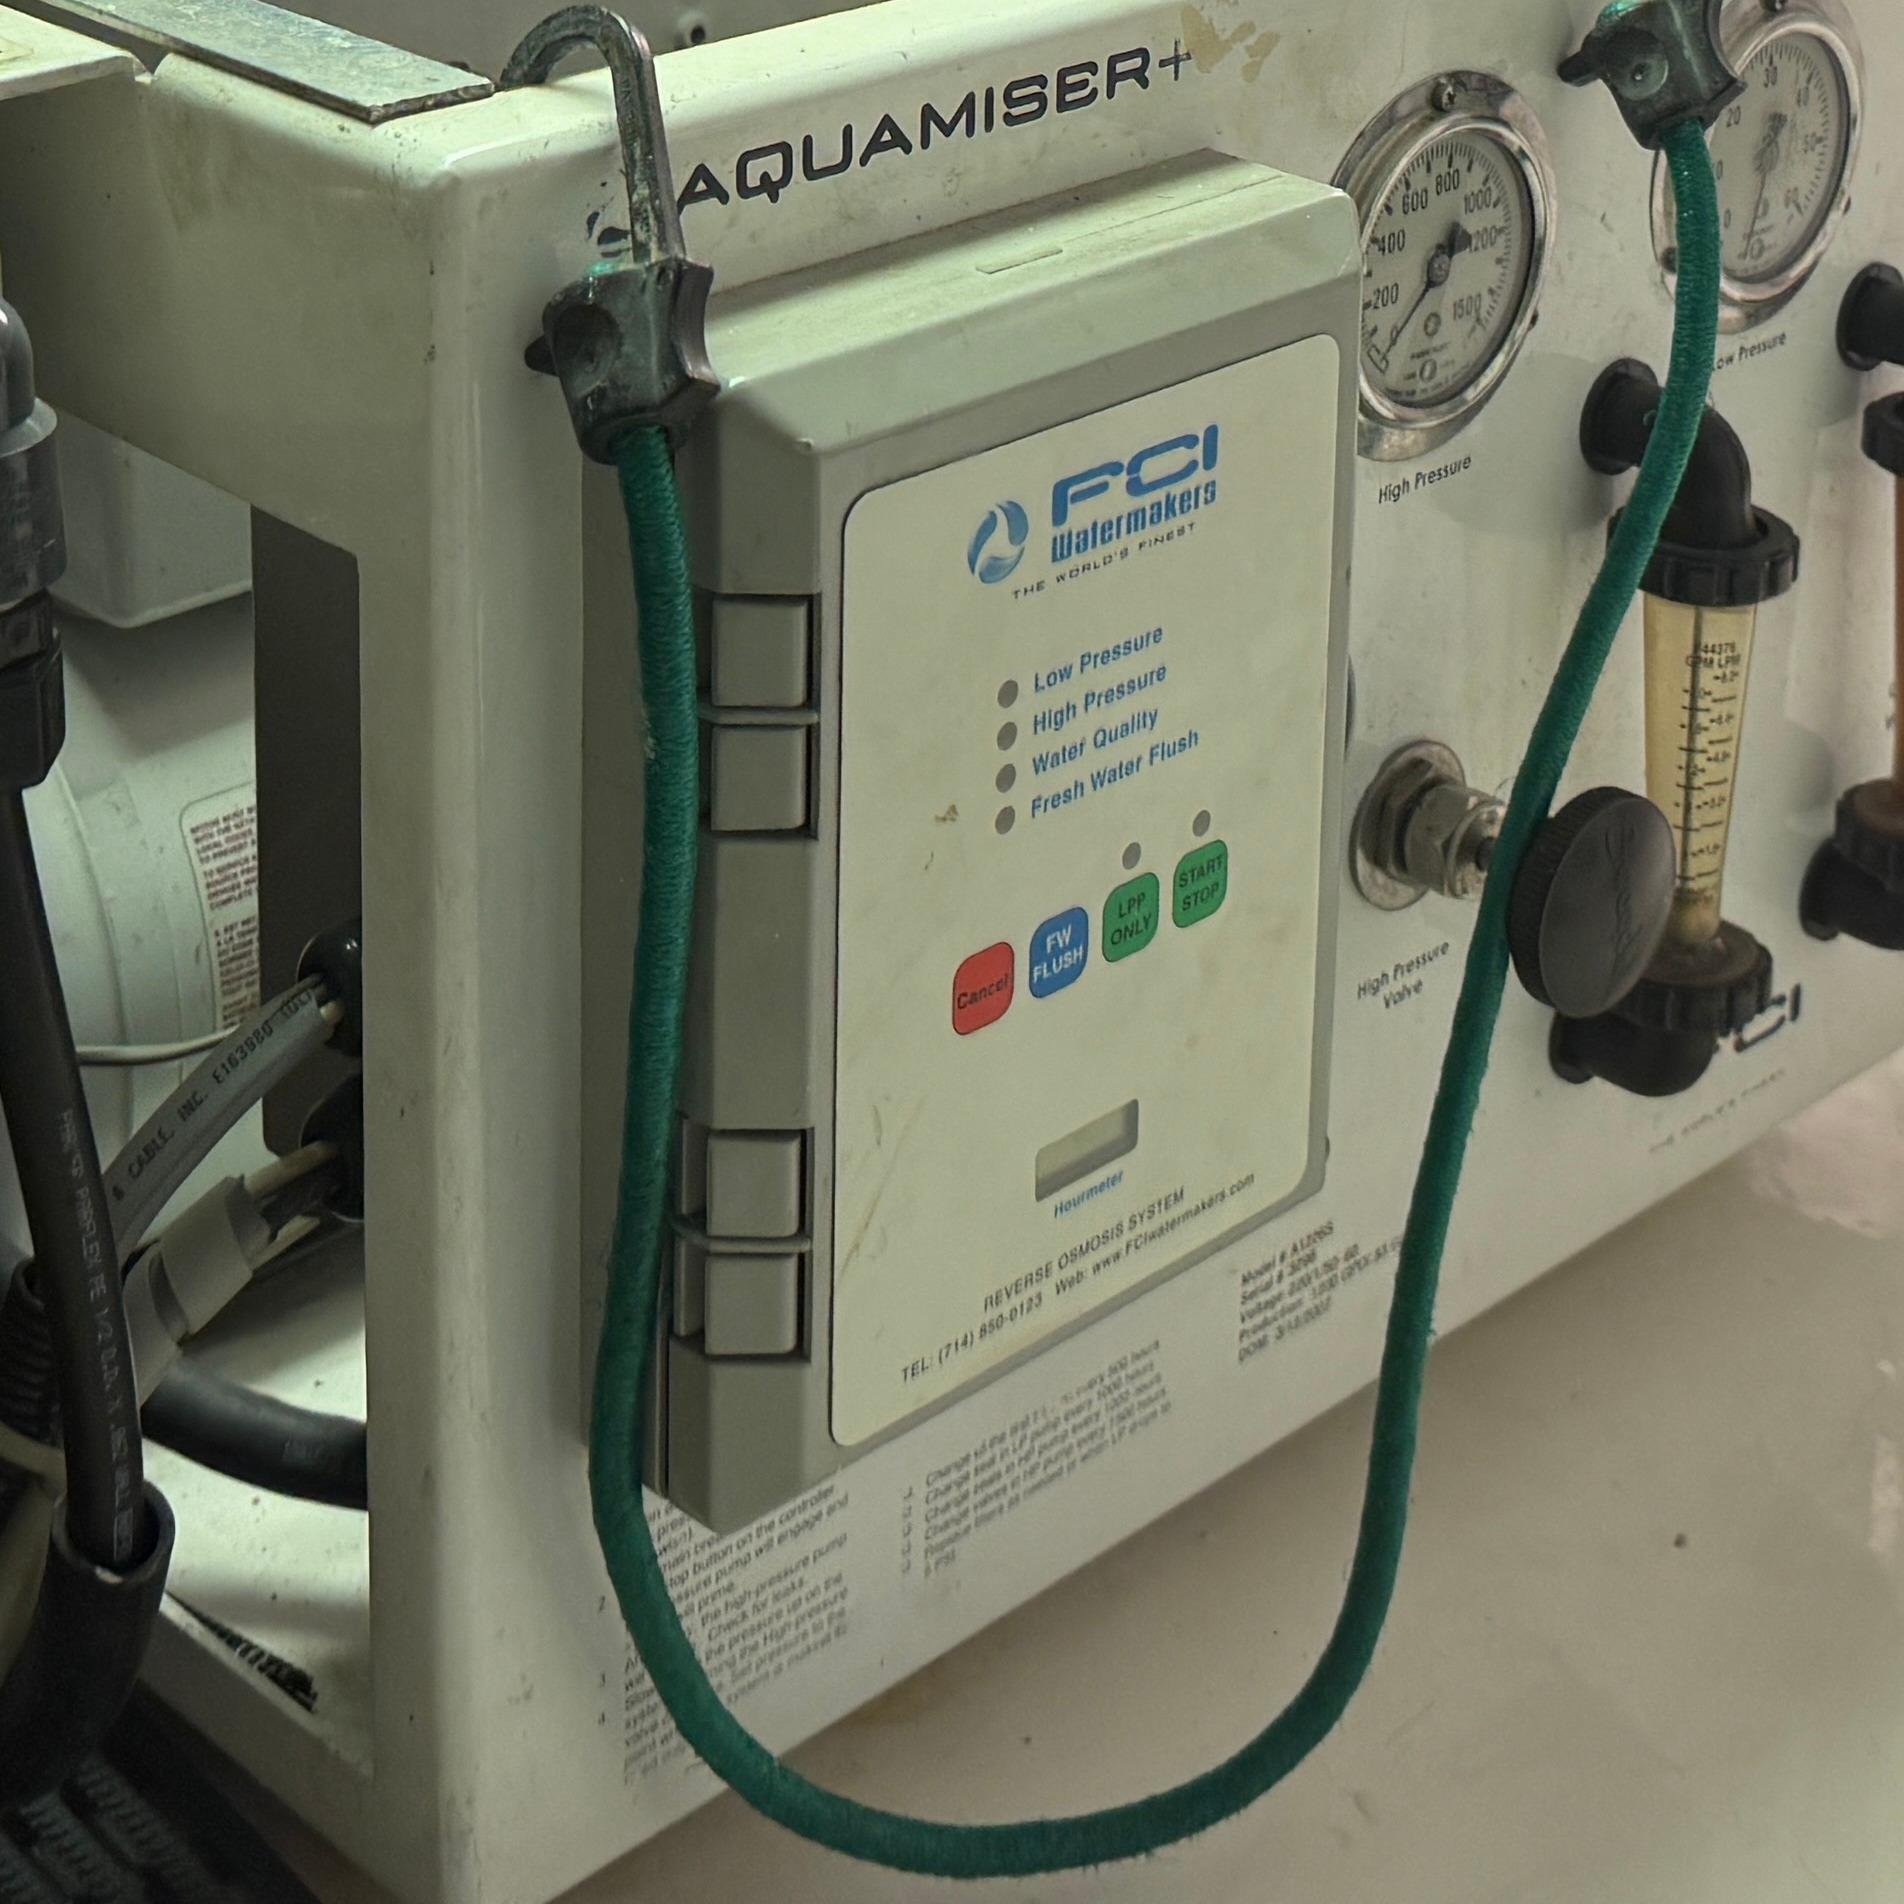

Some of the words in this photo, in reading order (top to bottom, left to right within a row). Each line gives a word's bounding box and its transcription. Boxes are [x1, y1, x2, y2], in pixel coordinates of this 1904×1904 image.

[1762, 65, 1779, 89] 30
[676, 37, 1193, 214] AQUAMISER+
[1725, 105, 1742, 129] 20
[1434, 167, 1461, 197] 800
[1401, 188, 1429, 216] 600
[1463, 188, 1494, 215] 1000
[1377, 229, 1406, 257] 400
[1372, 282, 1401, 311] 200
[1452, 292, 1483, 321] 1500
[1711, 353, 1735, 372] ow
[1738, 331, 1787, 362] Pressure
[1050, 423, 1219, 528] FCI
[1378, 477, 1410, 504] High
[1414, 454, 1472, 491] Pressure
[1051, 478, 1218, 564] Watermakers
[1011, 579, 1047, 600] THE
[1055, 547, 1131, 584] WORLD'S
[1138, 522, 1197, 551] FINEST
[1033, 663, 1074, 694] Low
[1079, 626, 1164, 676] Pressure
[1032, 702, 1078, 735] High
[1083, 663, 1168, 716] Pressure
[1031, 737, 1087, 776] Water
[1092, 707, 1160, 753] Quality
[1030, 781, 1085, 819] Fresh
[1089, 751, 1144, 791] Water
[1148, 728, 1200, 768] Flush
[1177, 853, 1224, 890] START
[1117, 891, 1147, 920] LPP
[1181, 881, 1220, 913] STOP
[1045, 924, 1073, 953] FW
[1110, 909, 1153, 946] ONLY
[1032, 947, 1085, 984] FLUSH
[1357, 971, 1391, 1001] High
[1393, 940, 1451, 983] Pressure
[956, 972, 1011, 1011] Cancel
[1382, 978, 1424, 1010] Valve
[1053, 1170, 1124, 1219] Hourmeter
[983, 1260, 1054, 1314] REVERSE
[1057, 1221, 1125, 1270] OSMOSIS
[1127, 1184, 1186, 1233] SYSTEM
[900, 1355, 934, 1384] TEL:
[937, 1329, 975, 1367] (714)
[978, 1292, 1043, 1342] 850-0123
[1054, 1269, 1089, 1297] Web:
